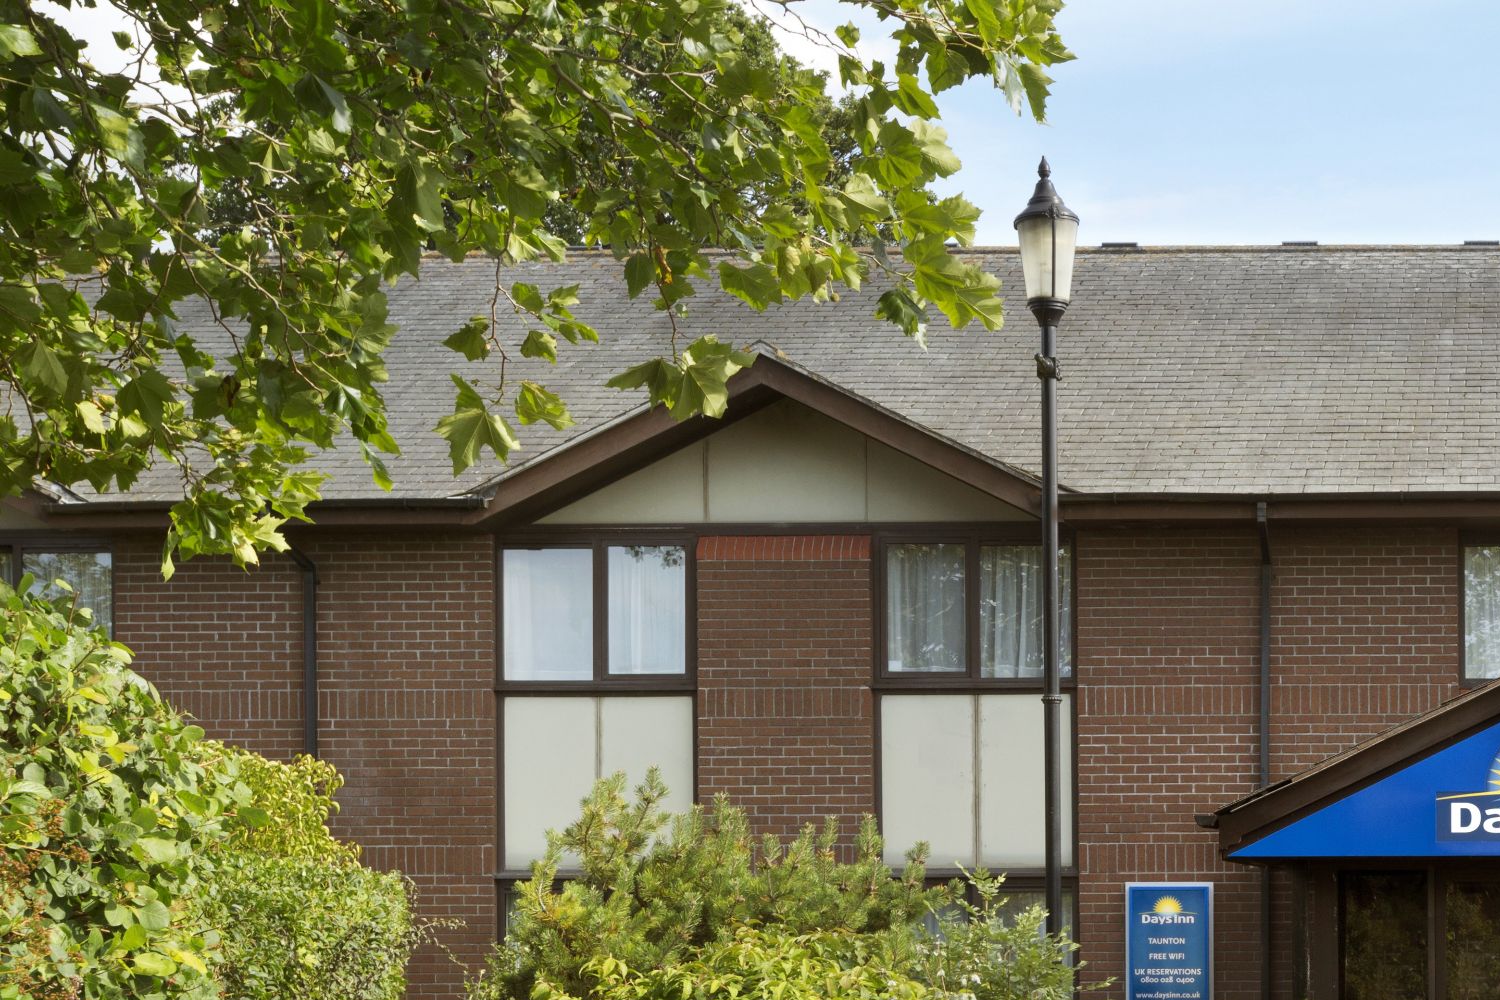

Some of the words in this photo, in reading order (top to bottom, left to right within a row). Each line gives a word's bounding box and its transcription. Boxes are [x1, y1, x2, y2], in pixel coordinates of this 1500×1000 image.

[1141, 914, 1173, 925] Days
[1173, 914, 1195, 924] Inn
[1148, 937, 1186, 945] TAUNTON
[1148, 952, 1167, 960] FREE
[1168, 952, 1185, 960] WIFI
[1134, 968, 1146, 976] UK
[1146, 968, 1202, 976] RESERVATIONS
[1176, 976, 1195, 984] 0400
[1135, 991, 1201, 1000] www.daysinn.co.uk
